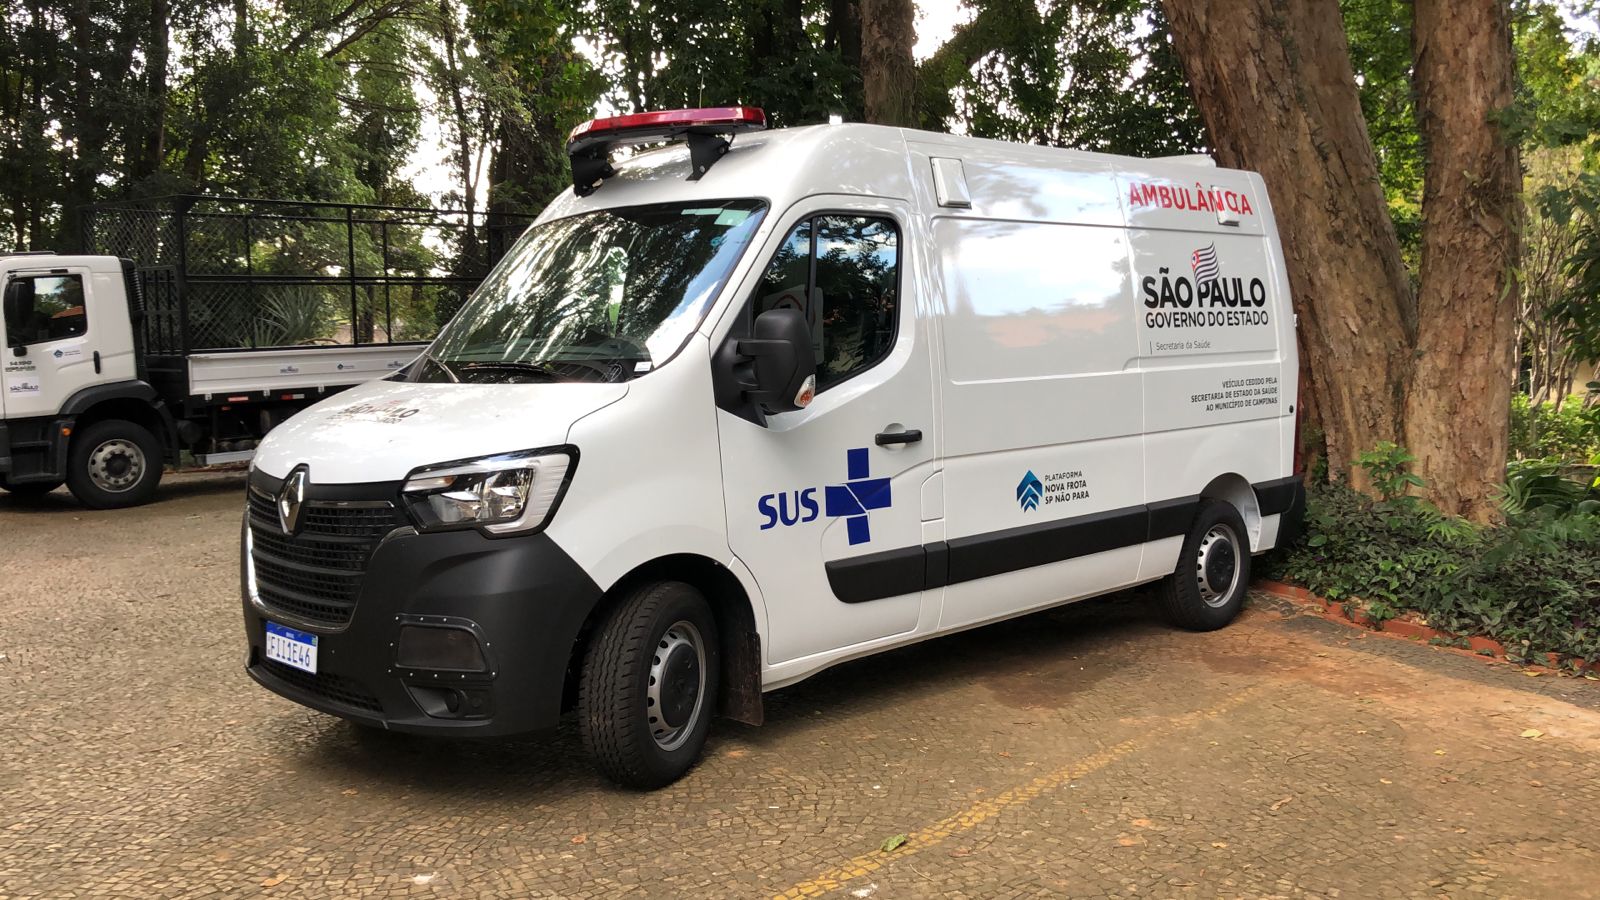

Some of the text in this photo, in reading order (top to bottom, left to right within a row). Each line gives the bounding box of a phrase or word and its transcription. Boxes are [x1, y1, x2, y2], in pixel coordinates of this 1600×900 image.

[1142, 266, 1266, 309] SÃO PAULO
[1145, 310, 1269, 329] GOVERNO DO ESTADO
[1155, 340, 1210, 351] Secretaria da Saúde
[1222, 378, 1244, 388] VEÍCULO
[1246, 378, 1264, 386] CEDIDO
[1191, 392, 1224, 402] SECRETARIA
[1225, 391, 1232, 399] DE
[1233, 388, 1253, 398] ESTADO
[1254, 388, 1261, 396] DA
[1206, 403, 1214, 411] AO
[1245, 399, 1252, 407] DE
[1253, 397, 1277, 406] CAMPINAS
[1045, 470, 1082, 481] PLATAFORMA
[1045, 479, 1087, 494] NOVA FROTA
[1045, 490, 1090, 505] SP NÃO PARA
[758, 487, 819, 530] SUS
